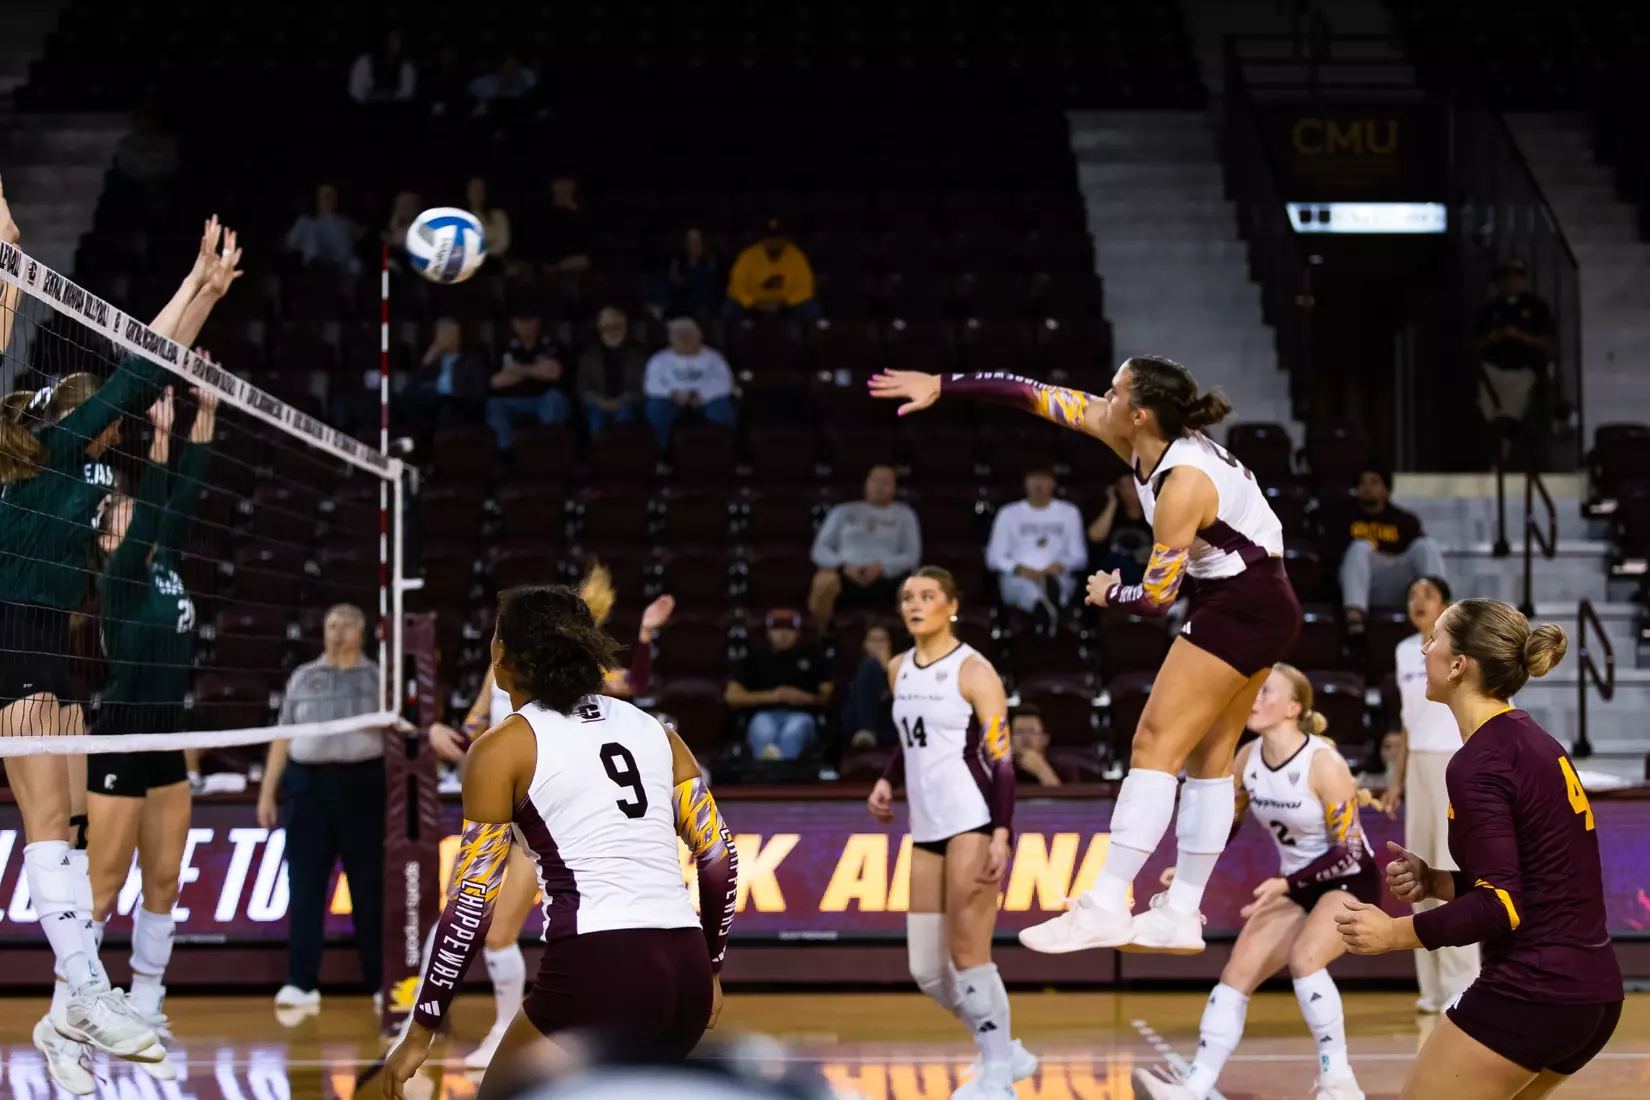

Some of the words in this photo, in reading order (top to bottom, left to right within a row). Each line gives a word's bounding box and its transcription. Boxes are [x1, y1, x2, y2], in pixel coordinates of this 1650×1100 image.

[1292, 117, 1399, 155] CMU
[902, 716, 927, 748] 14
[599, 742, 649, 819] 9
[1558, 755, 1595, 832] 4
[1270, 820, 1297, 846] 2
[214, 828, 290, 922] TO
[430, 879, 489, 991] CHIPPEWAS
